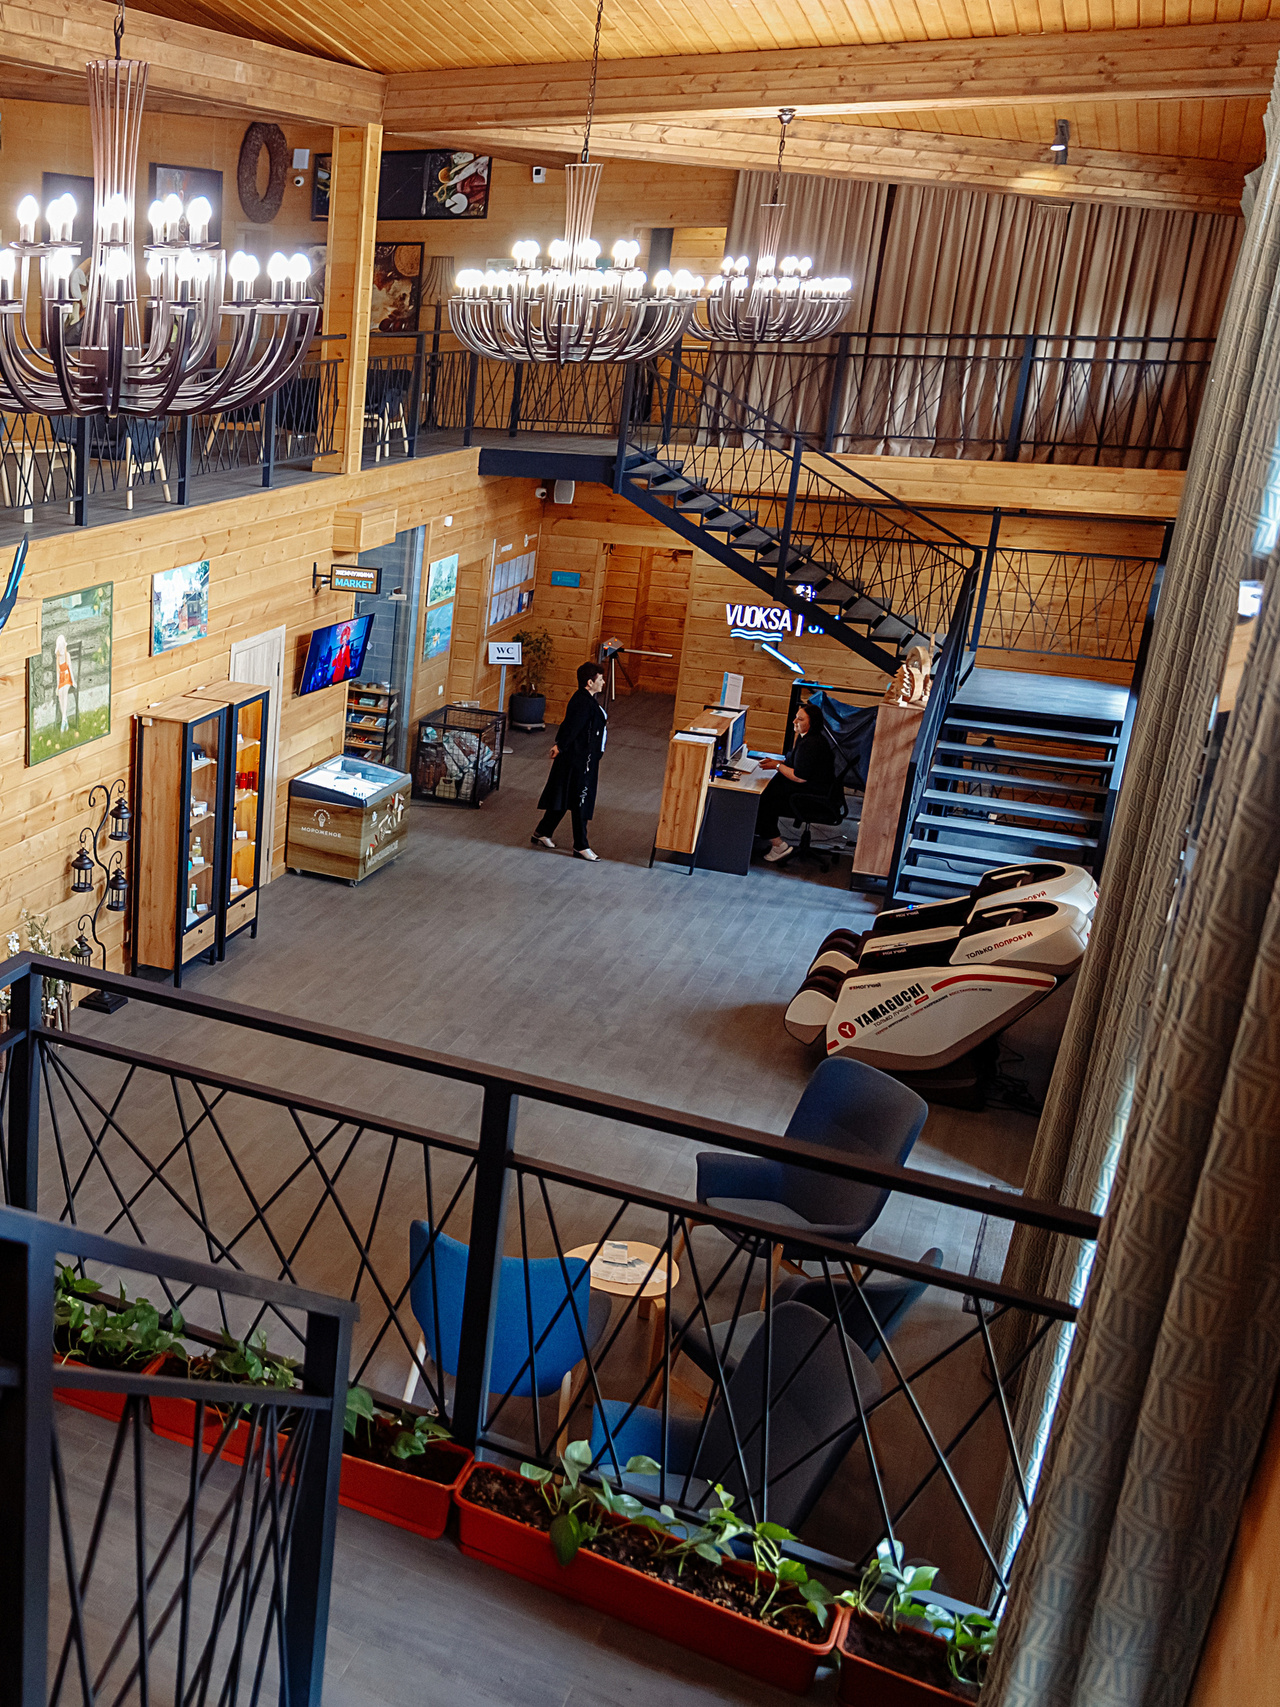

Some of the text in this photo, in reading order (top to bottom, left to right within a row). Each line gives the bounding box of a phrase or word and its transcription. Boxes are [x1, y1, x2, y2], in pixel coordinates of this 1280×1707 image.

[335, 577, 374, 589] MARKET
[726, 603, 792, 632] VUOKSA
[496, 647, 514, 655] WC
[301, 826, 342, 839] МОРОЖЕНОЕ
[965, 930, 1034, 960] ТОЛЬКО ПОПРОБУЙ
[854, 983, 926, 1028] YAMAGUCHI
[873, 1003, 913, 1028] ТОЛЬКО ЛУЧШЕЕ
